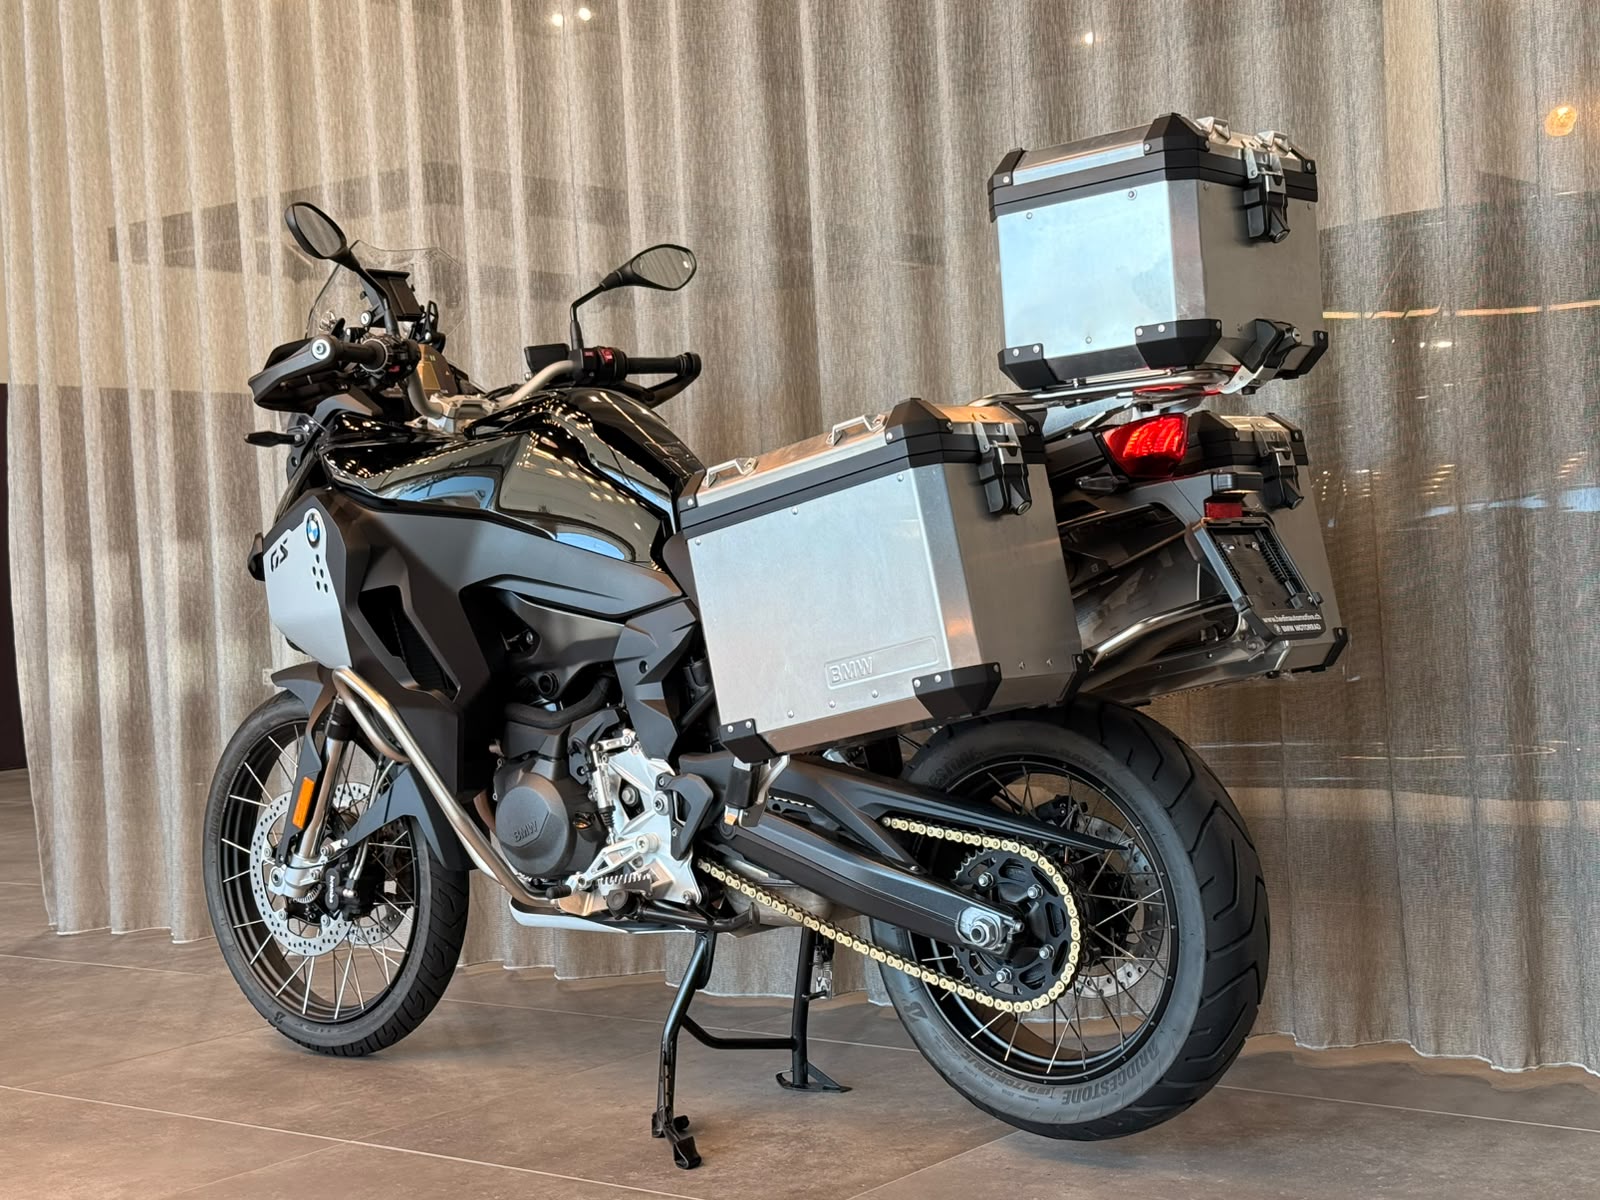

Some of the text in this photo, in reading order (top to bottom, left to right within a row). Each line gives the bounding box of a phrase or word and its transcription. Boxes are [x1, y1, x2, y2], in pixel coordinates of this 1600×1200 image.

[270, 537, 289, 573] GS
[828, 656, 874, 684] BMW
[513, 820, 539, 843] BMW
[1061, 1037, 1160, 1106] BRIDGESTONE
